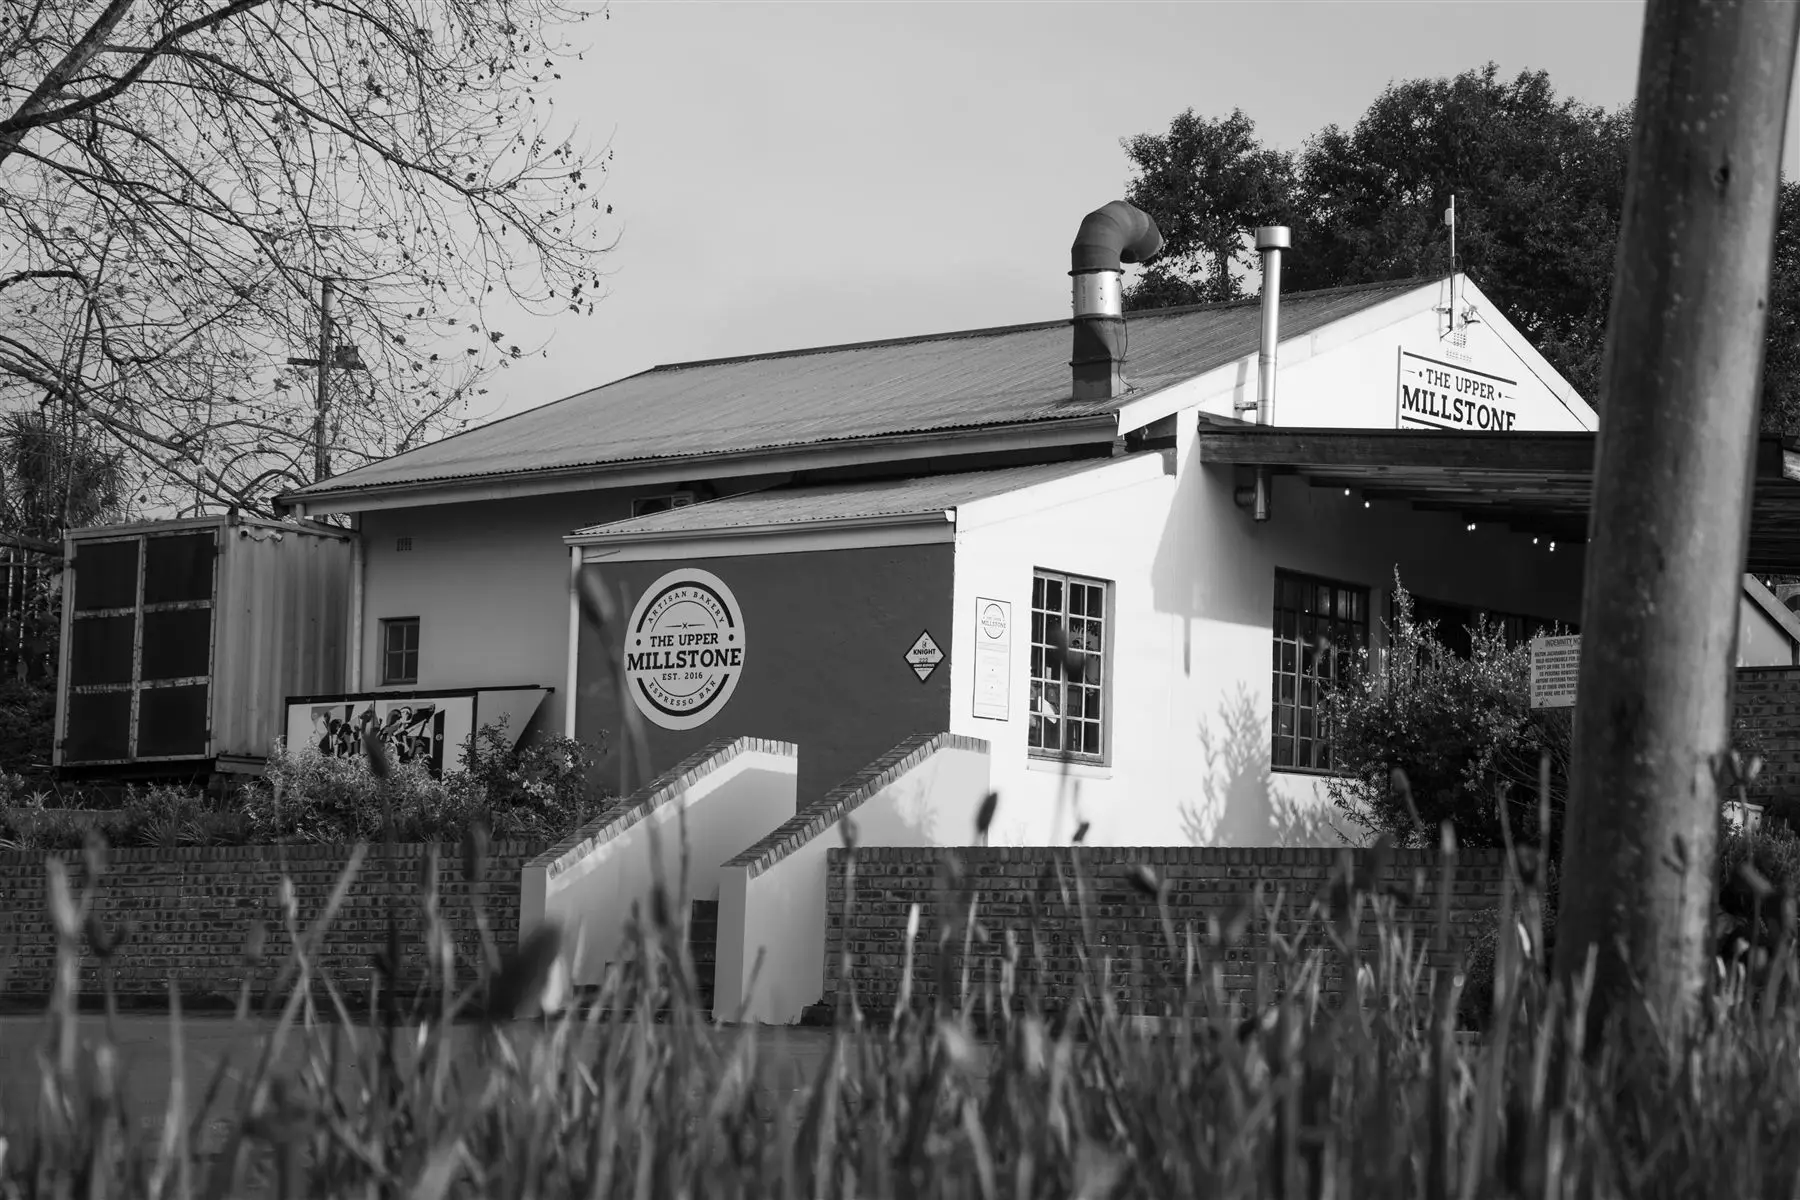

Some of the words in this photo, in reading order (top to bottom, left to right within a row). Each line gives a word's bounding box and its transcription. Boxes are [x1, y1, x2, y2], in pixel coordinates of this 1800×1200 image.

[1426, 368, 1451, 389] THE
[1456, 376, 1495, 401] UPPER
[1402, 384, 1516, 431] MILLSTONE
[648, 590, 687, 624] ARTISAN
[693, 591, 725, 624] BAKERY
[650, 635, 674, 648] THE
[678, 633, 719, 646] UPPER
[913, 648, 936, 656] KNIGHT
[627, 648, 742, 671] MILLSTONE
[662, 673, 681, 681] EST.
[684, 672, 703, 680] 2016
[649, 682, 694, 706] ESPRESSO
[699, 680, 716, 699] BAR
